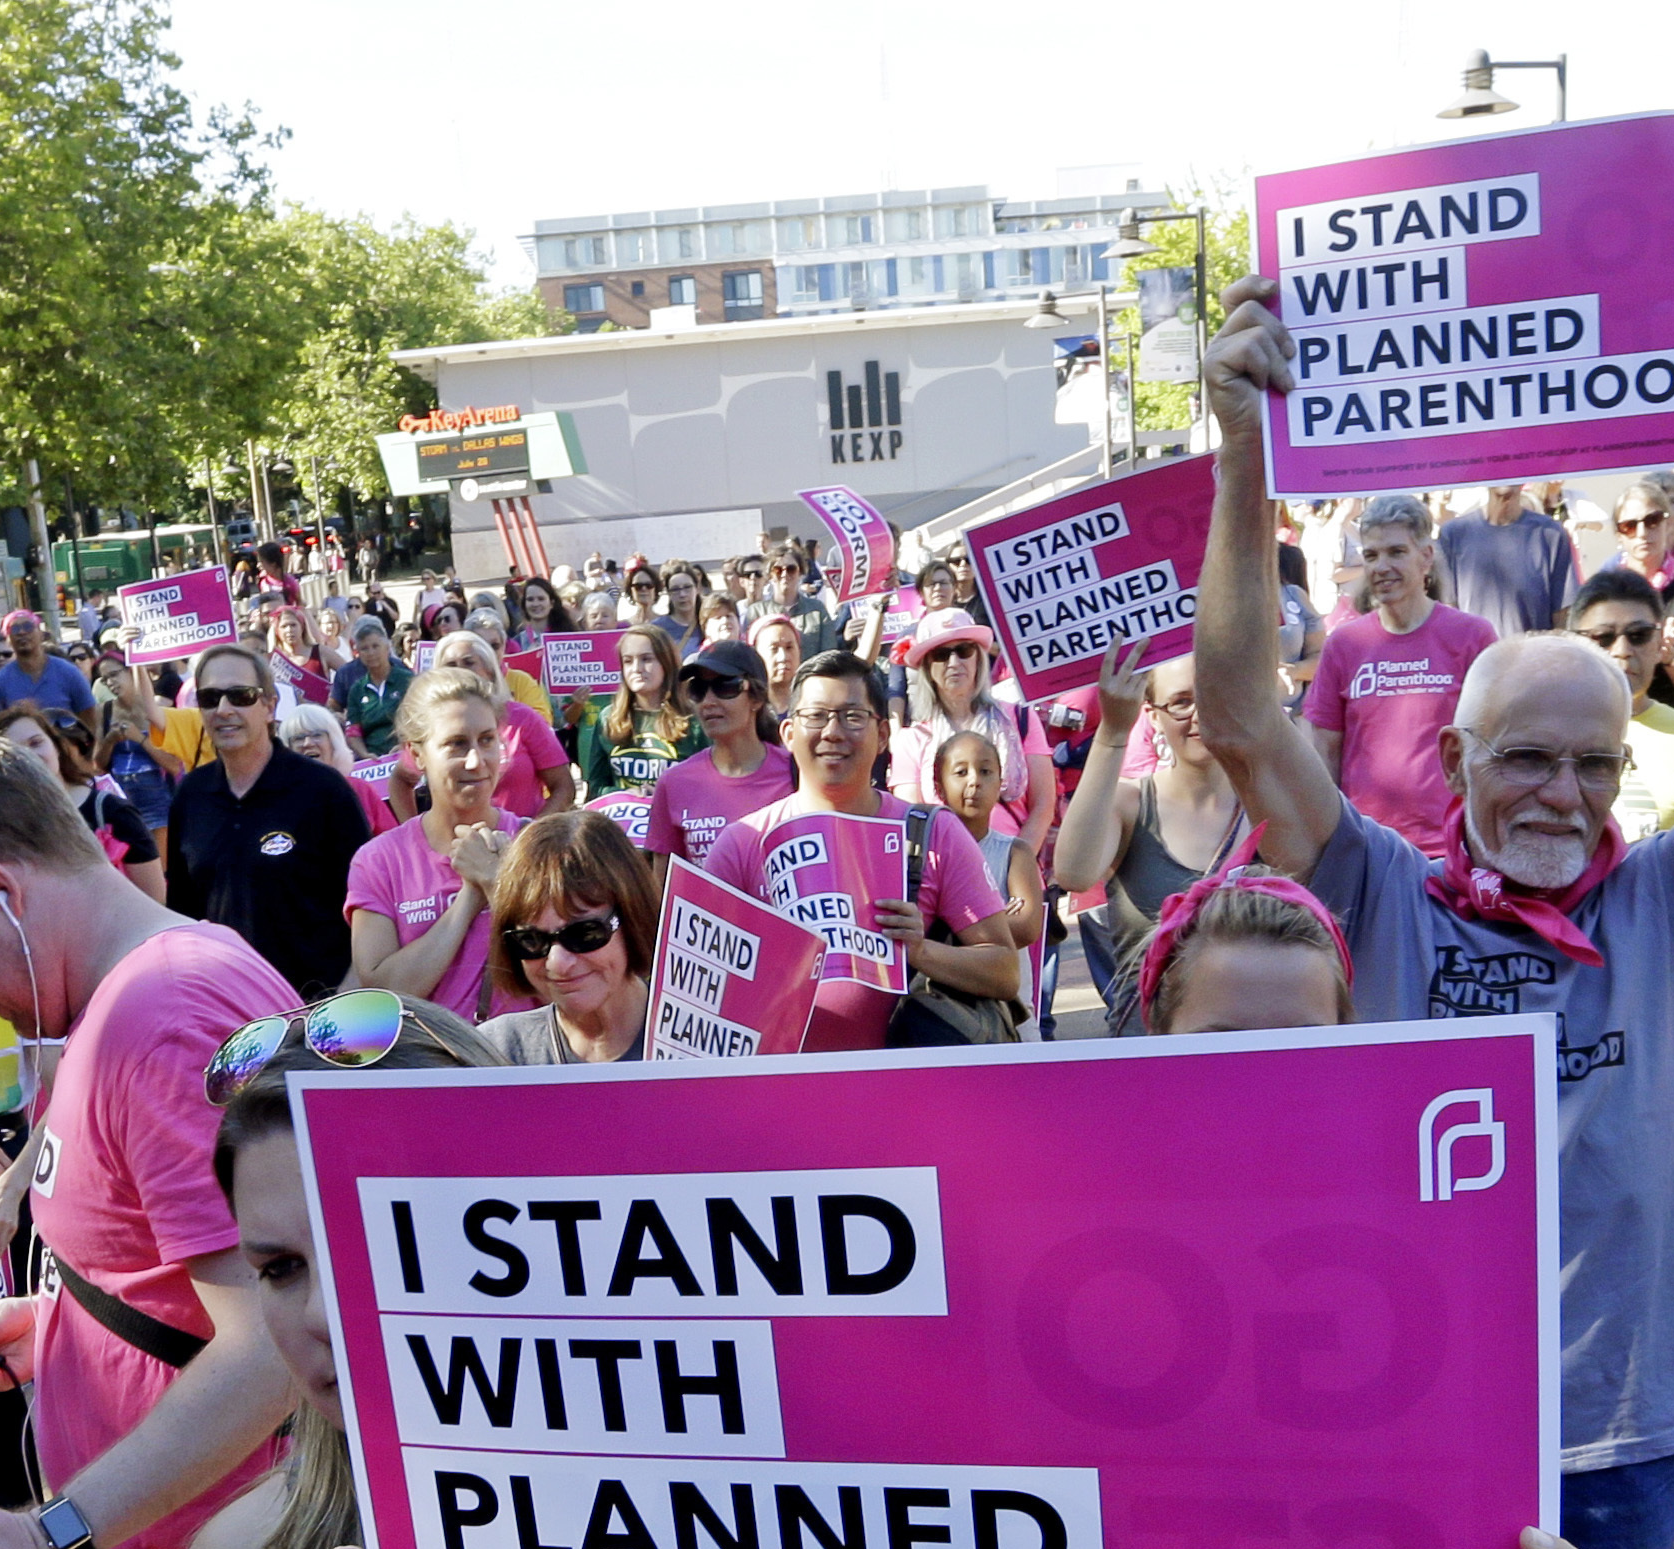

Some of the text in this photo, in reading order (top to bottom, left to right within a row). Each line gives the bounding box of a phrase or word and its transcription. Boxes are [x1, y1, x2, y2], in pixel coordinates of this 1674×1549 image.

[1294, 187, 1528, 257] I STAND
[1292, 258, 1450, 316] WITH
[1298, 309, 1585, 380] PLANNED
[429, 404, 520, 432] KeyArena
[462, 438, 496, 451] DALLAS
[831, 429, 904, 464] KEXP
[994, 511, 1121, 573] I STAND
[1003, 556, 1090, 604] WITH
[131, 606, 166, 623] WITH
[135, 588, 179, 608] STAND
[1015, 569, 1168, 638] PLANNED
[135, 623, 227, 651] PARENTHOOD
[554, 641, 590, 652] STAND
[550, 652, 577, 662] WITH
[552, 663, 601, 674] PLANNED
[1378, 658, 1429, 673] Planned
[682, 816, 726, 830] STAND
[683, 809, 688, 819] I
[674, 906, 753, 970] I STAND
[670, 951, 721, 1005] WITH
[1453, 951, 1552, 984] STAND
[1440, 977, 1515, 1013] WITH
[659, 1001, 754, 1057] PLANNED
[390, 1191, 919, 1300] I STAND
[406, 1334, 747, 1438] WITH
